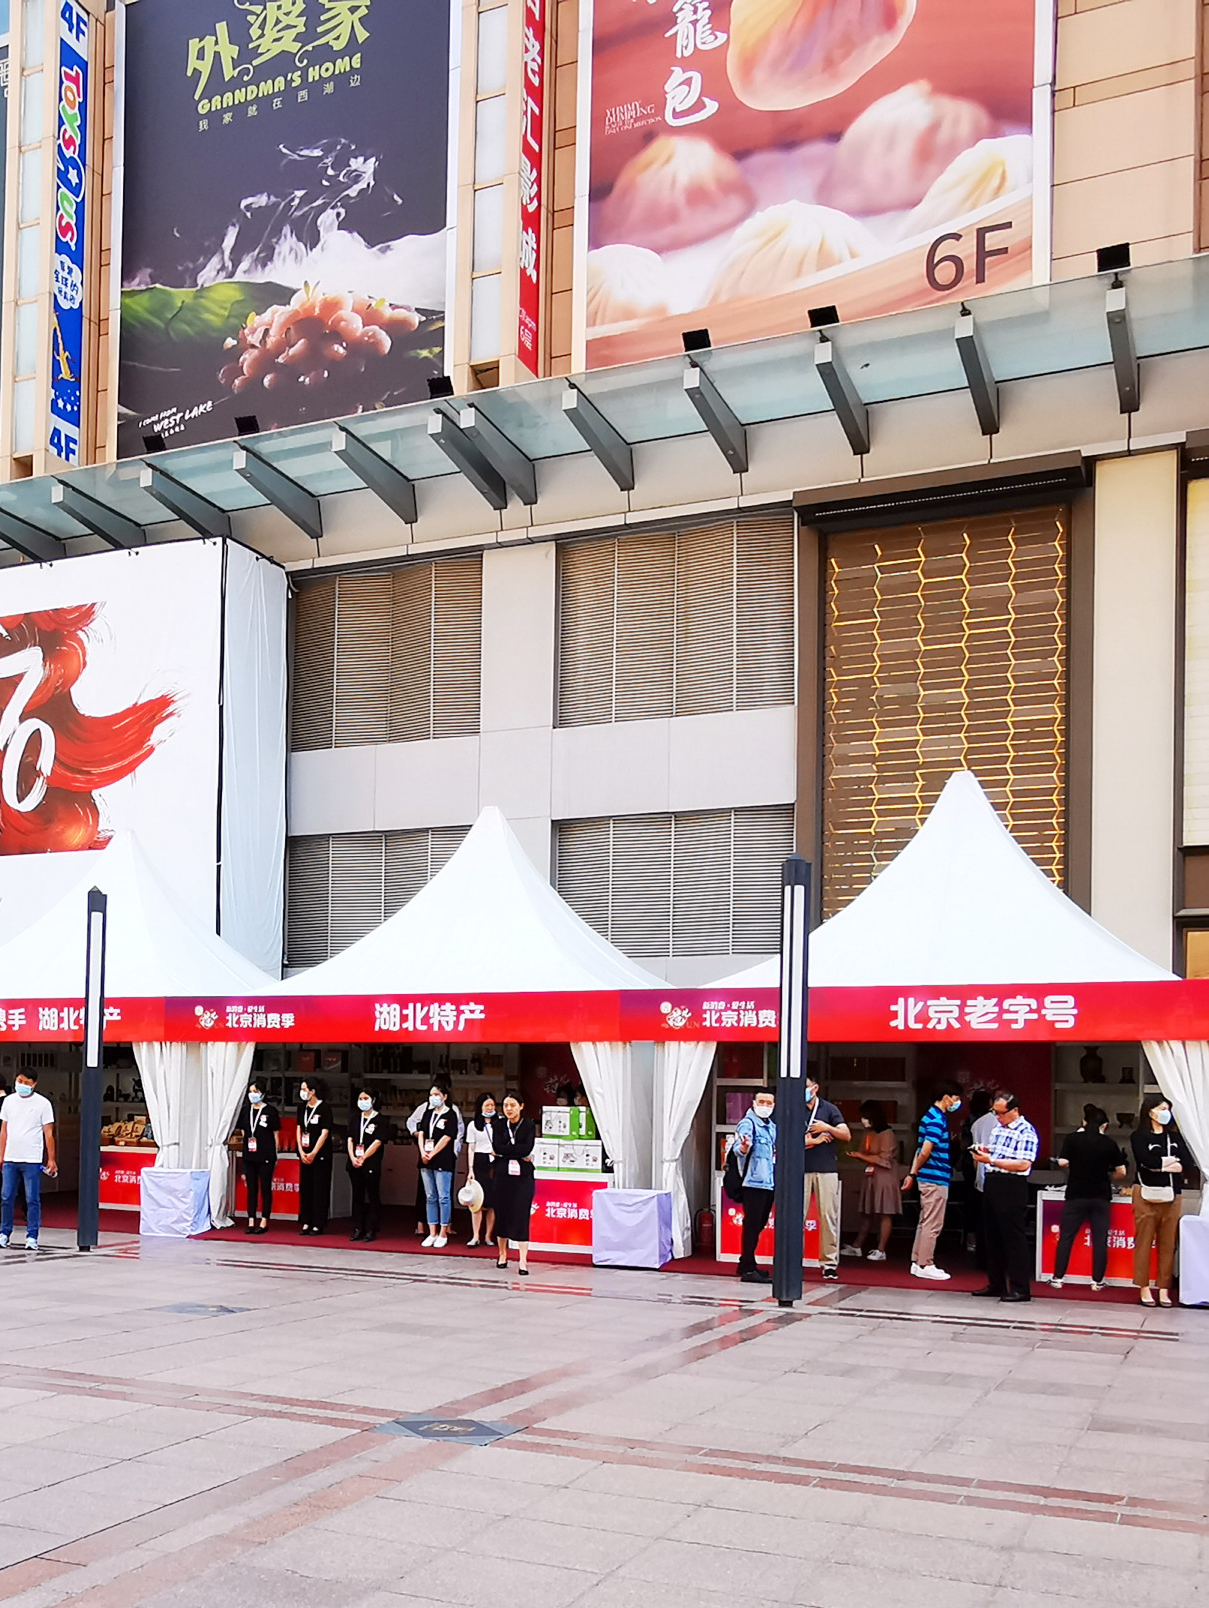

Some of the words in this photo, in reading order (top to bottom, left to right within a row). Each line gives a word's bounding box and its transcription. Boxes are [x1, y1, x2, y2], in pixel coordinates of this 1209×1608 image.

[61, 1, 88, 42] 4F
[187, 0, 371, 100] 外婆家
[197, 71, 302, 115] GRANDMA'S
[308, 53, 361, 84] HOME
[198, 74, 361, 133] 我家就在西湖边
[926, 221, 1012, 292] 6F
[153, 412, 183, 432] WEST
[184, 400, 213, 420] LAKE
[50, 426, 78, 462] 4F
[226, 1013, 295, 1029] 北京消费季
[374, 1002, 486, 1032] 湖北特产
[702, 1010, 778, 1028] 北京消费
[890, 996, 1078, 1031] 北京老字号
[545, 1207, 593, 1220] 北京消费
